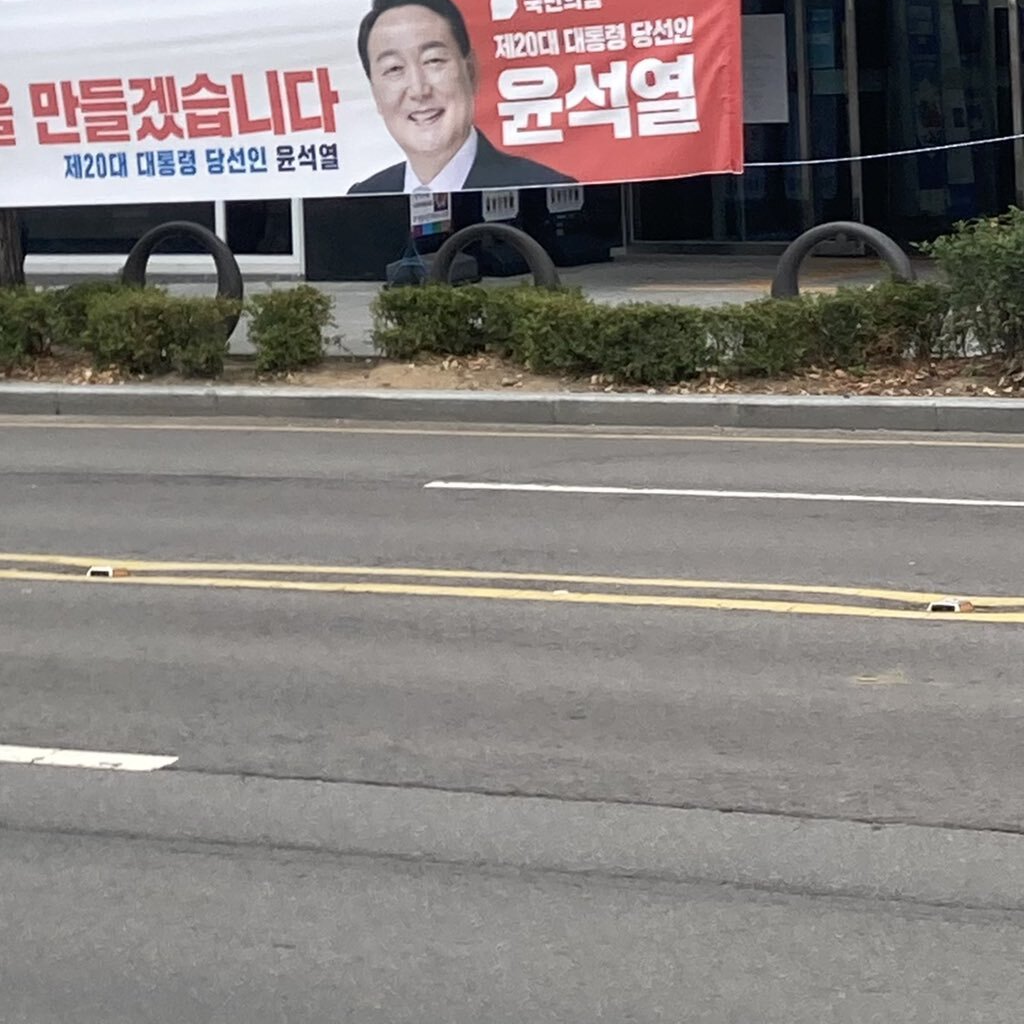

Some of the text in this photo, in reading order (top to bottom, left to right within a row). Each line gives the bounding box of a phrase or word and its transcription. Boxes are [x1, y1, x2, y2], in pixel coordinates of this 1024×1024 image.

[494, 17, 693, 58] 제20대 대통령 당선인
[29, 67, 339, 144] 만들겠습니다
[498, 54, 700, 145] 윤석열
[64, 144, 338, 178] 제20대 대통령 당선인 윤석열
